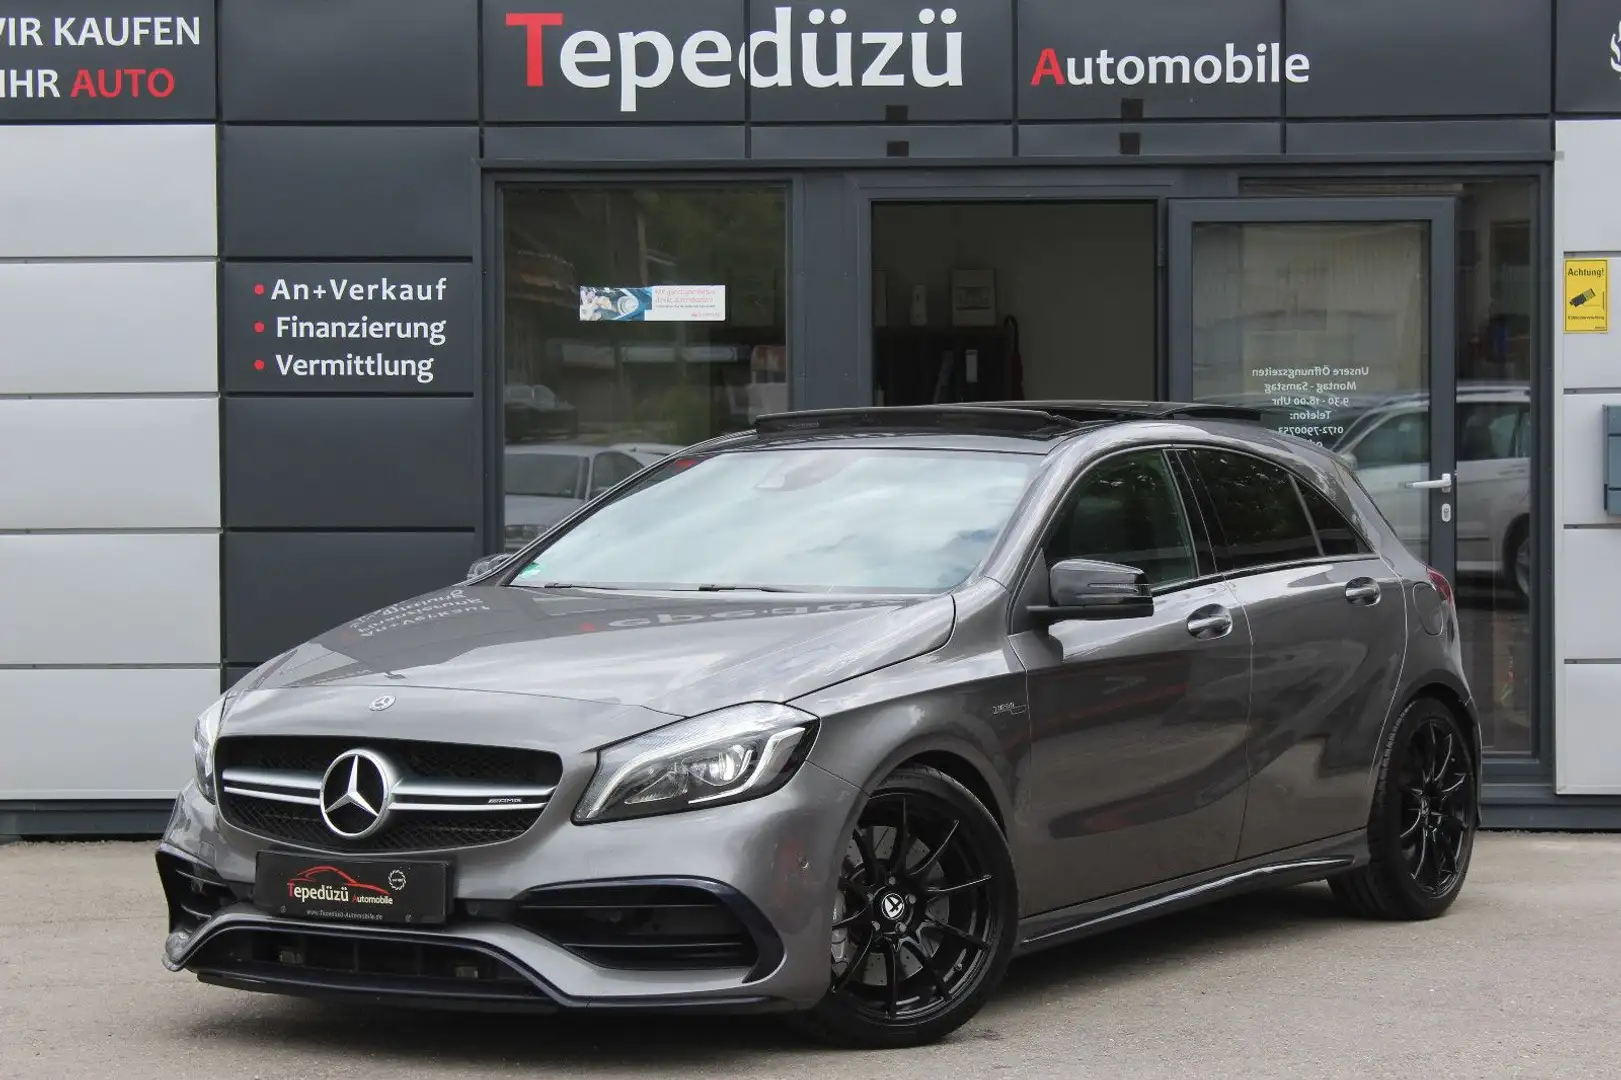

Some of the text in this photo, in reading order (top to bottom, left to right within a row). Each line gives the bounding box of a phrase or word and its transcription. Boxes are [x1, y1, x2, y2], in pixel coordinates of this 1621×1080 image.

[0, 17, 200, 46] IR KAUFEN
[504, 6, 1310, 112] Tepedüzü Automobile
[70, 68, 175, 98] AUTO
[1568, 268, 1604, 277] Achtung!
[270, 277, 447, 301] An+Verkauf
[276, 315, 447, 346] Finanzierung
[275, 353, 434, 384] Vermittlung
[287, 882, 393, 905] Tepedüzü Automobile
